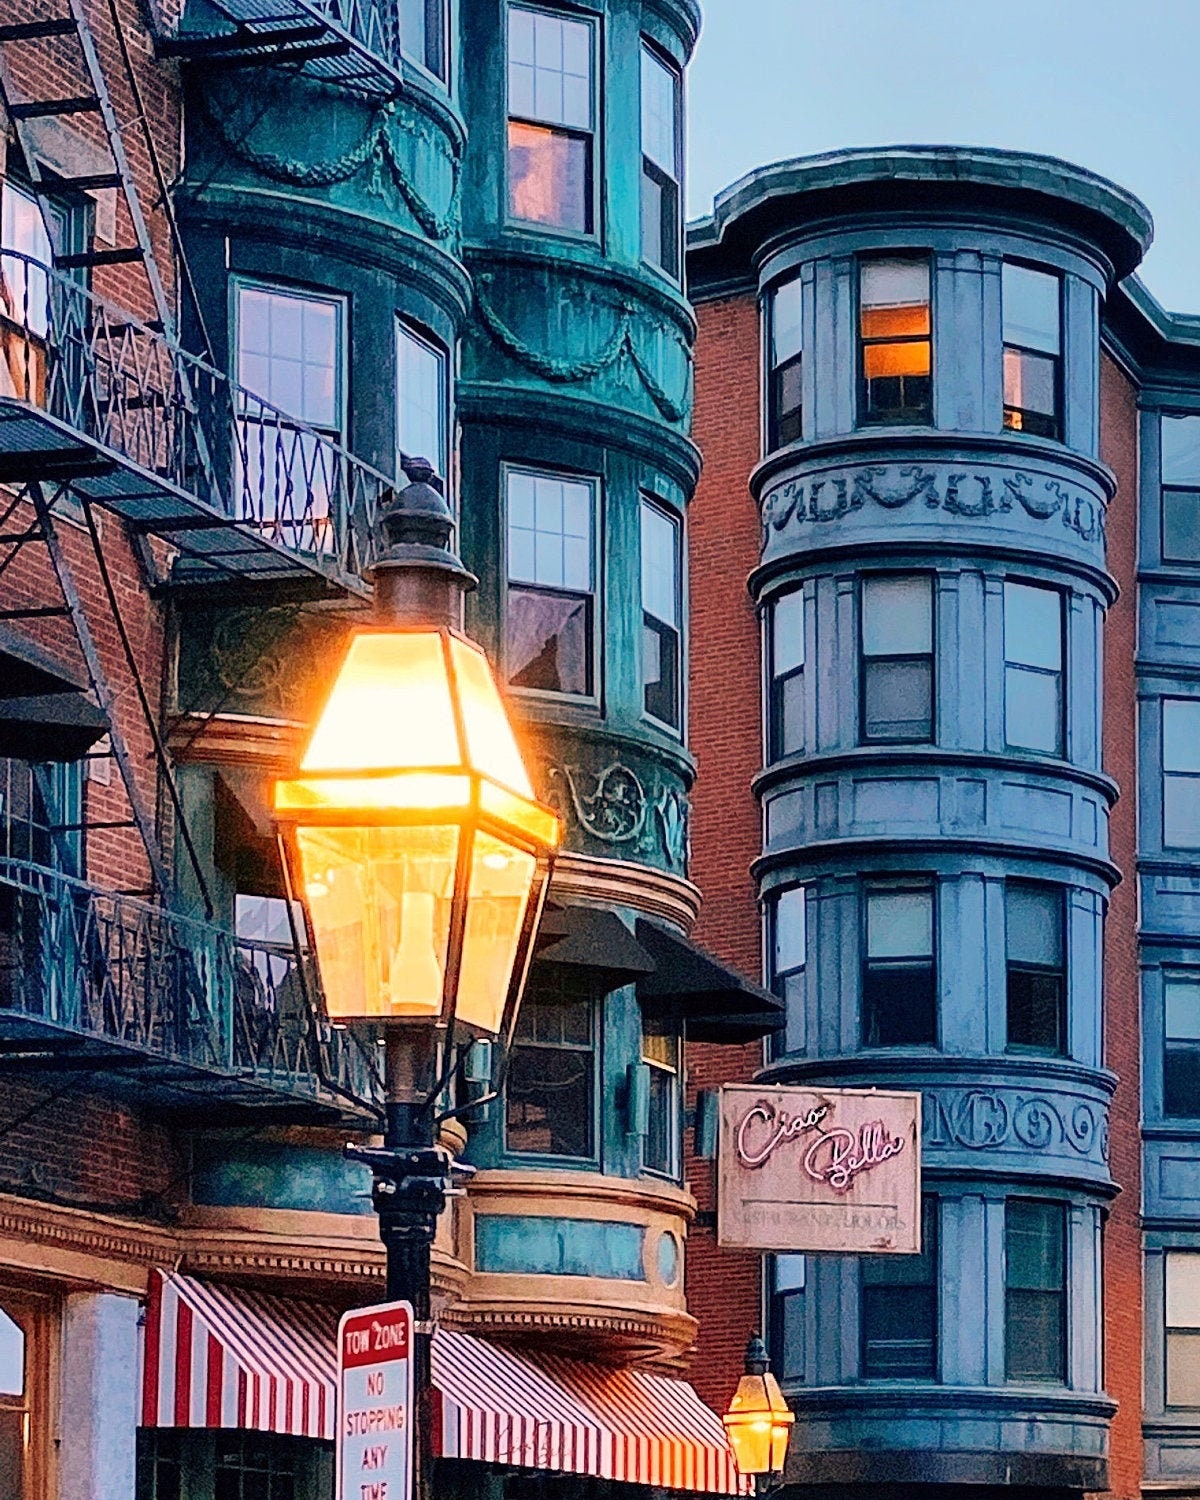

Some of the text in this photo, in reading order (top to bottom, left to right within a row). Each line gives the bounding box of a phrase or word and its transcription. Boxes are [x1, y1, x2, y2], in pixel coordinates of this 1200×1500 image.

[738, 1106, 828, 1164] Ciao
[804, 1122, 905, 1188] Bella
[346, 1321, 406, 1355] TOW ZONE
[367, 1372, 385, 1396] NO
[346, 1405, 404, 1436] STOPPING
[361, 1445, 388, 1470] ANY
